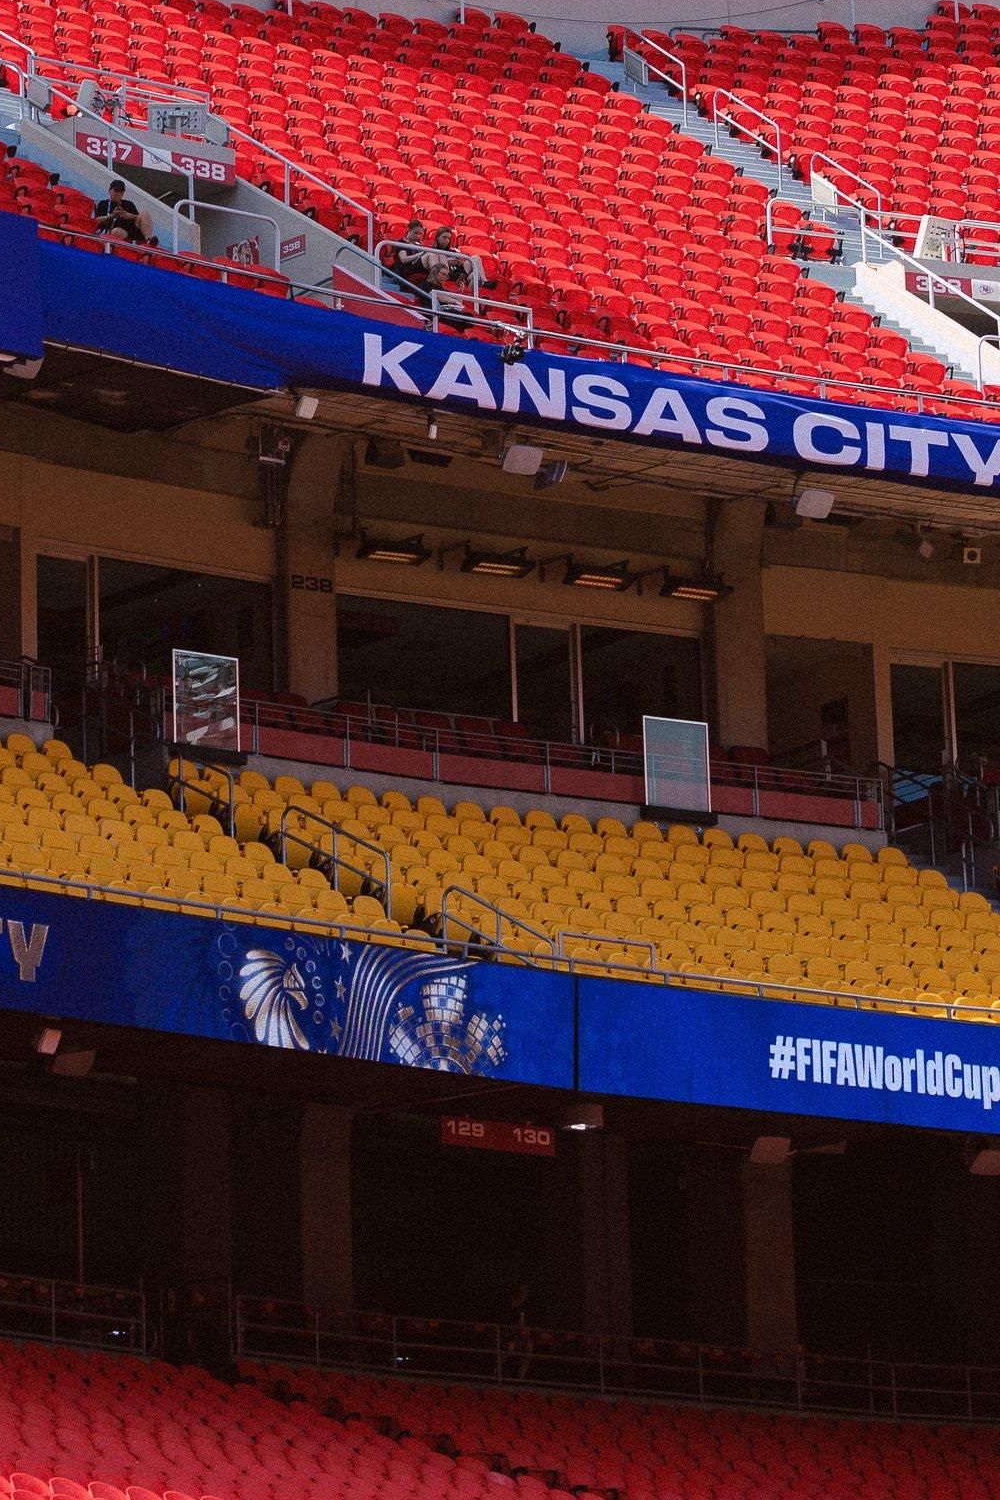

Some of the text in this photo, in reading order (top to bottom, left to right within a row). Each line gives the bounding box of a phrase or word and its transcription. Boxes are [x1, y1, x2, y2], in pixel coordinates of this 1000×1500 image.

[86, 136, 226, 182] 337 338
[282, 240, 301, 254] 338
[361, 332, 1000, 486] KANSAS CITY
[291, 574, 334, 594] 238
[768, 1034, 1000, 1110] #FIFAWorldCup
[447, 1120, 550, 1146] 129 130
